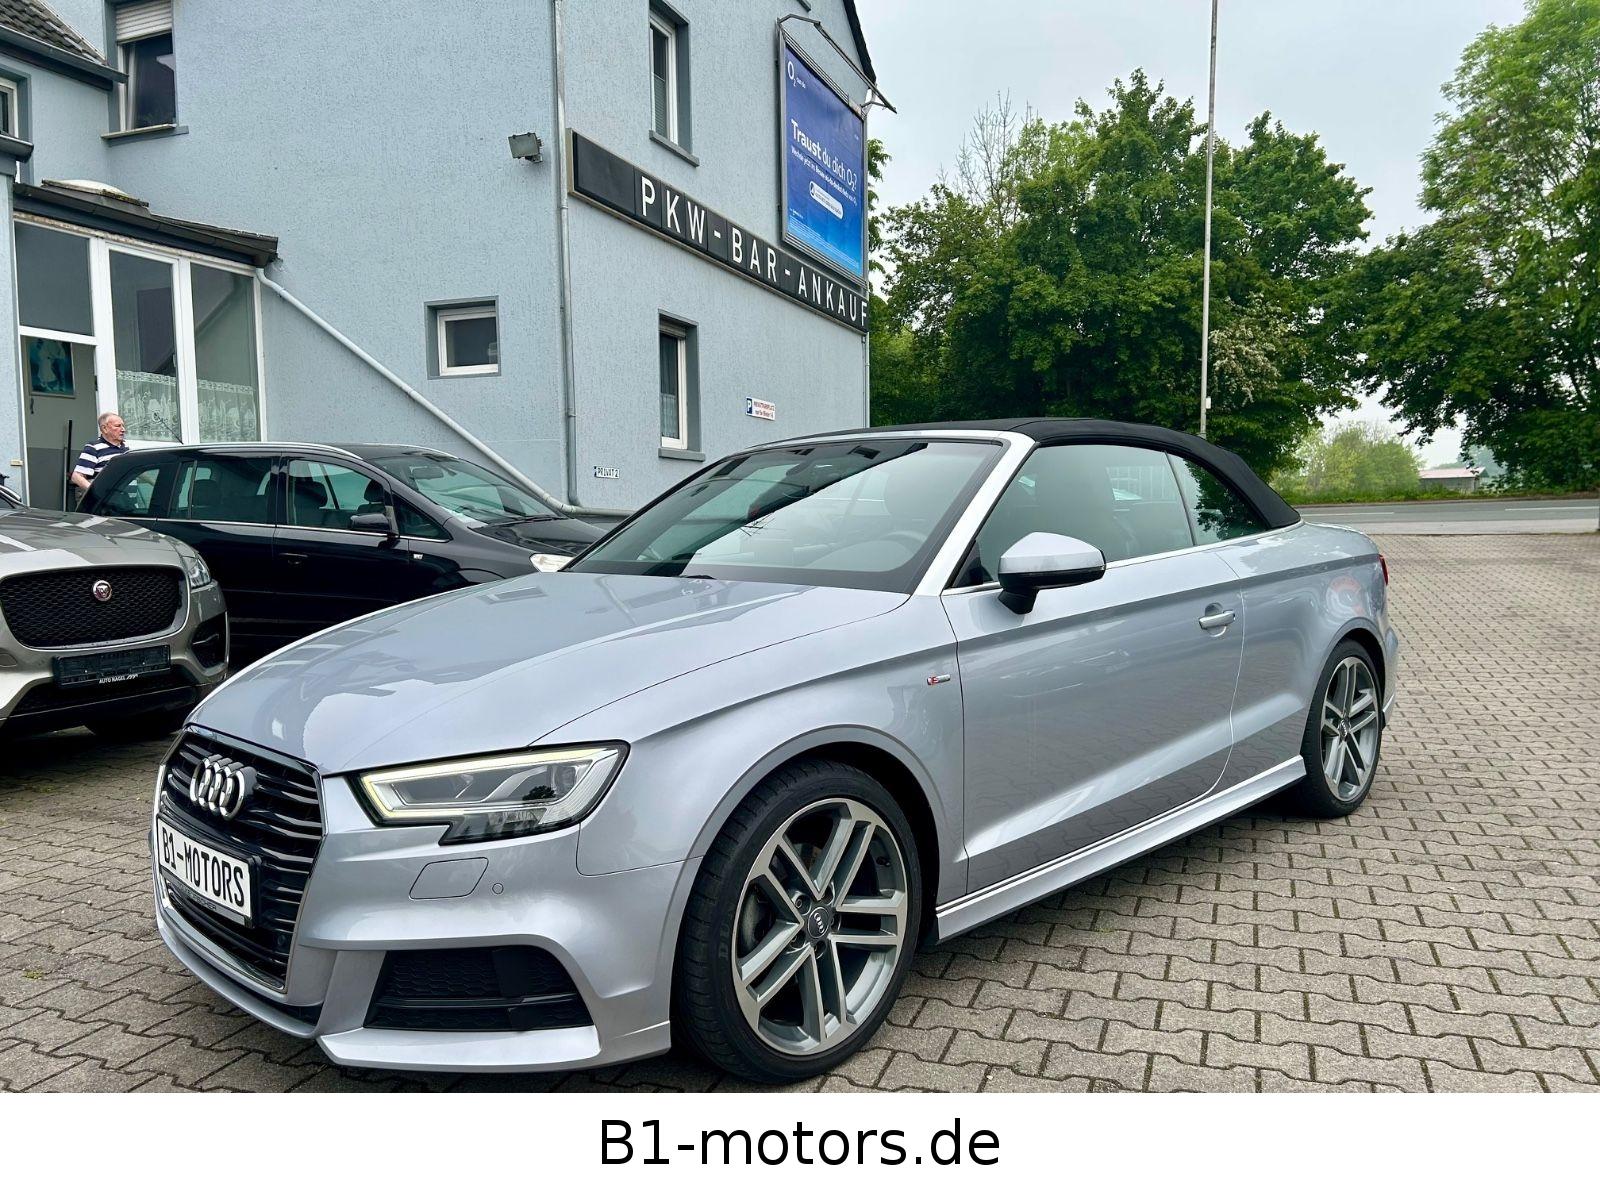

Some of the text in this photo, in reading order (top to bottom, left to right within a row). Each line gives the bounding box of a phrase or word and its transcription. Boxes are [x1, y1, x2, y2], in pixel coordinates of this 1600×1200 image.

[791, 118, 821, 160] Traust
[822, 147, 831, 168] du
[832, 156, 846, 181] dich
[614, 469, 619, 478] 2
[162, 826, 245, 907] B1-MOTORS
